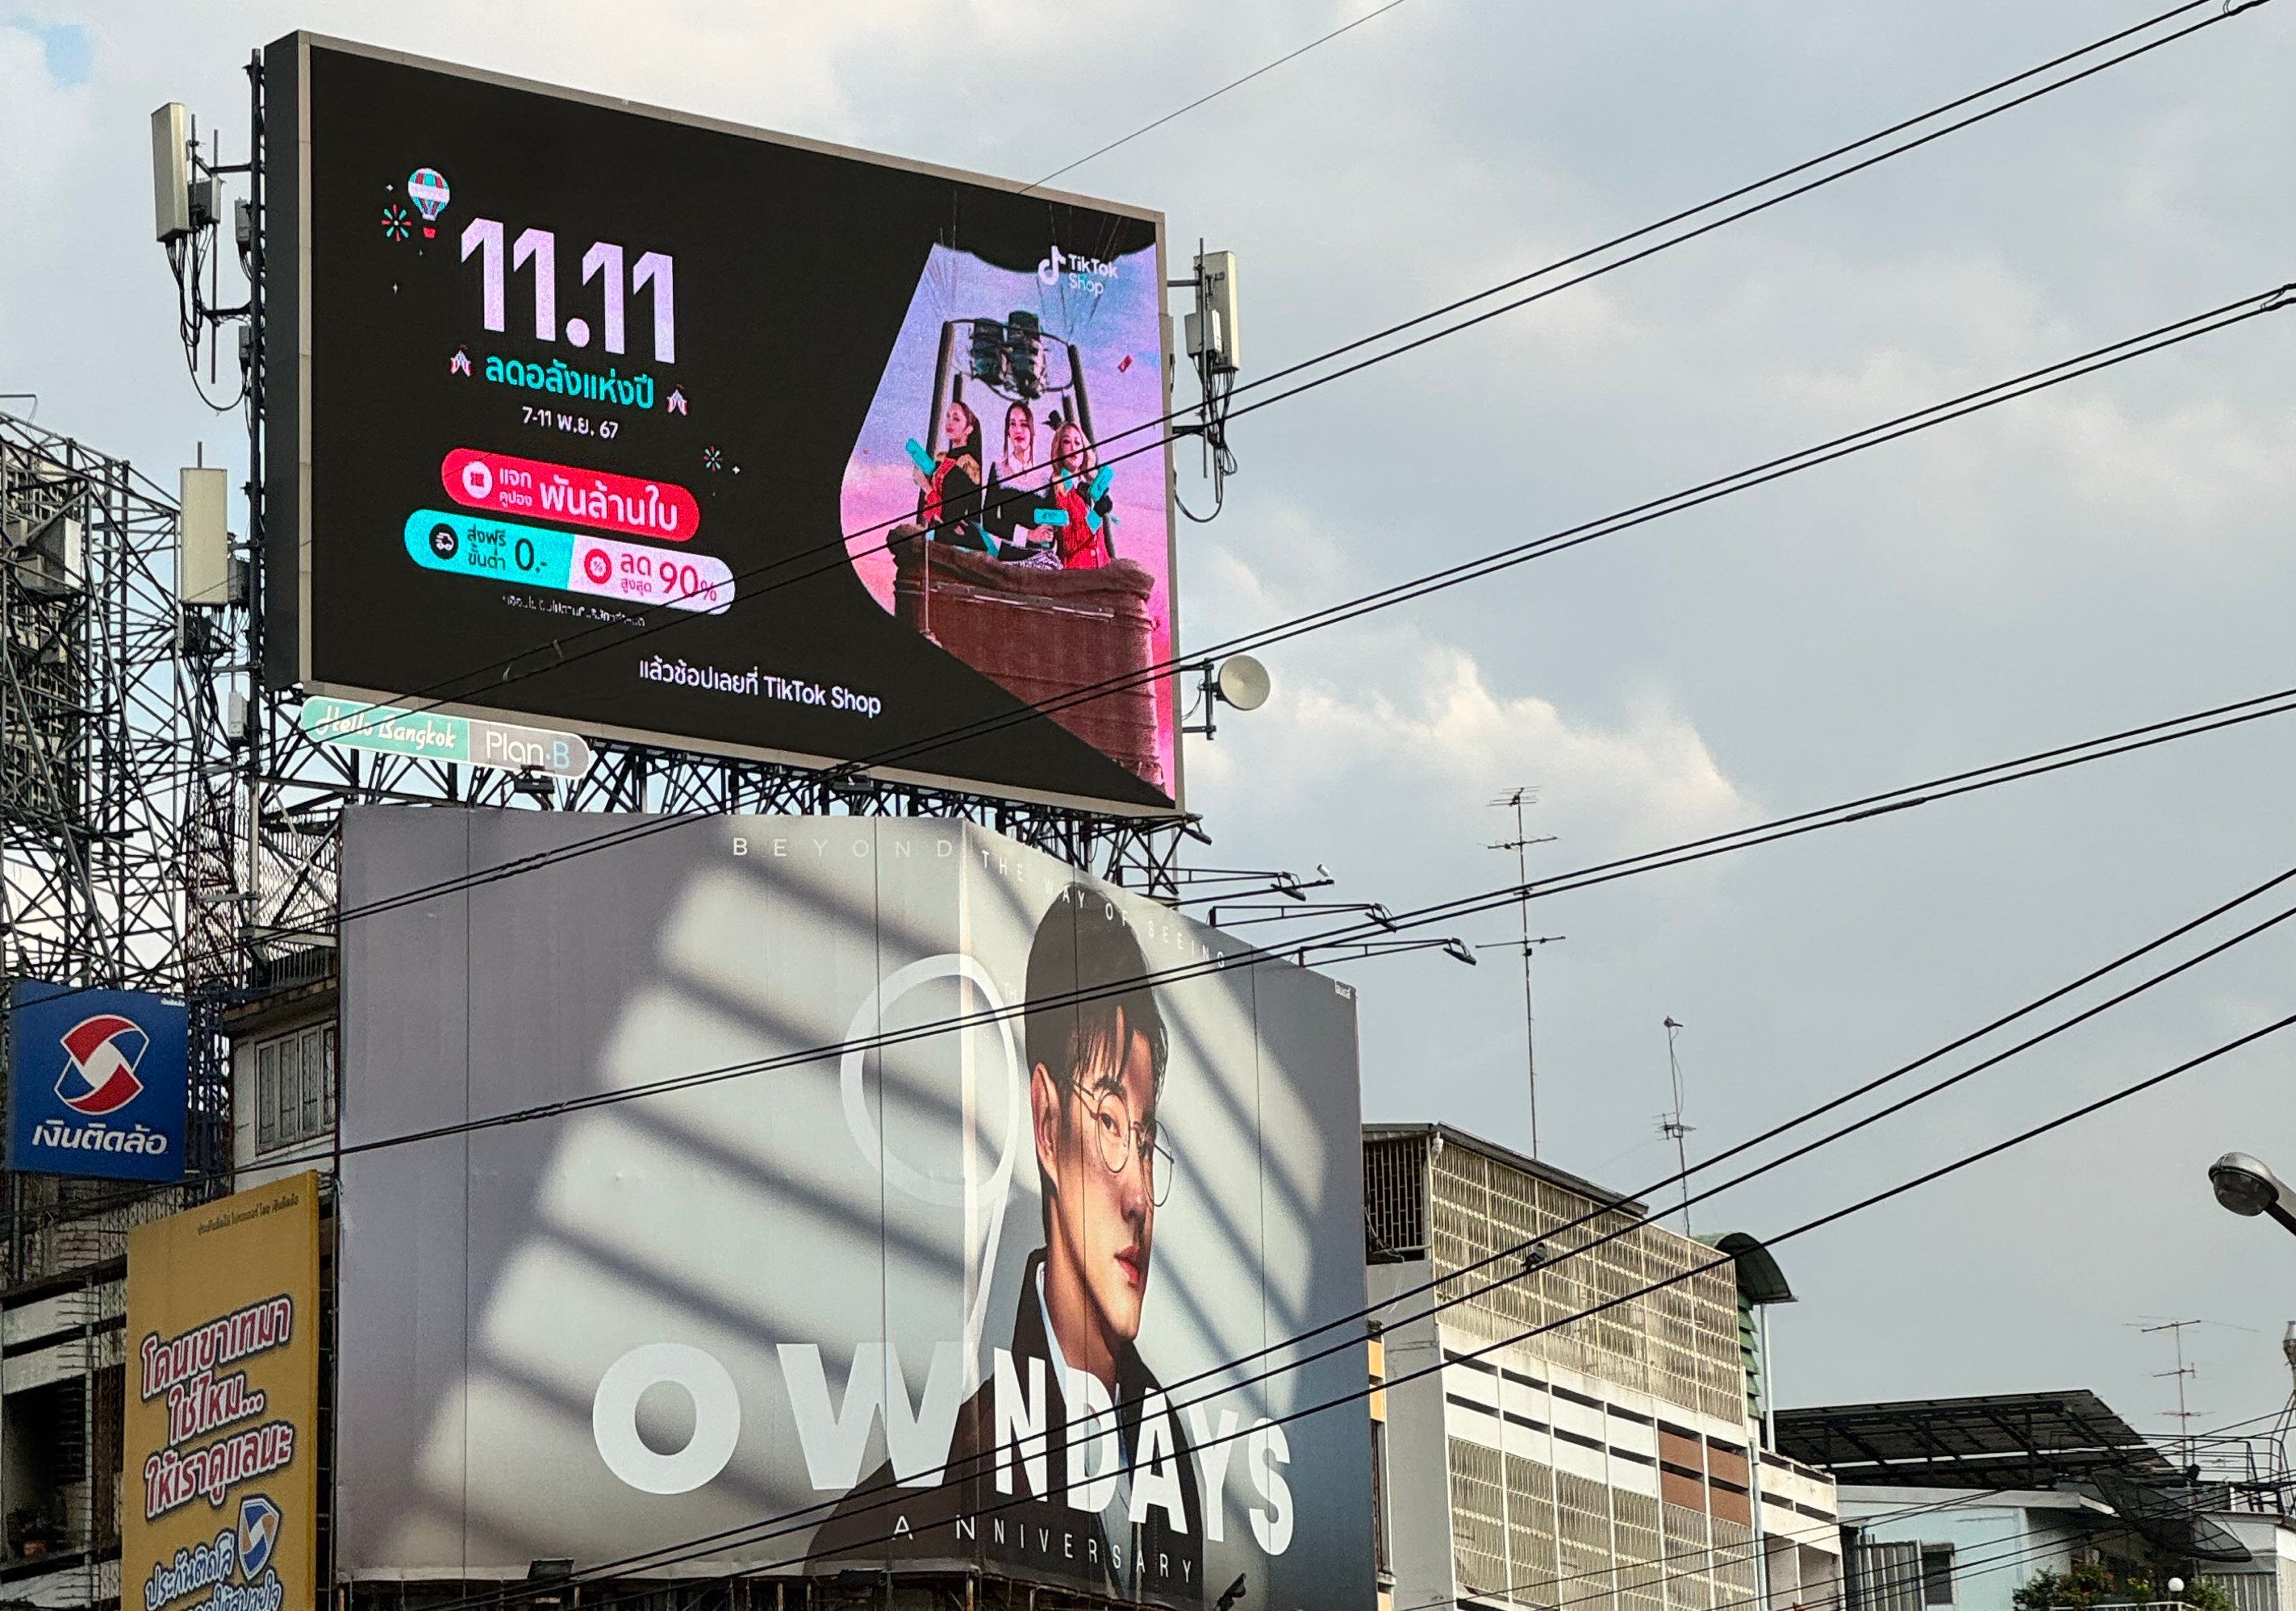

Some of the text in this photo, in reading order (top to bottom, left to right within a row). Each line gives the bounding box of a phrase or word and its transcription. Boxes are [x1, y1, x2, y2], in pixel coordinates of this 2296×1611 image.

[1068, 253, 1118, 278] TikTok
[1069, 272, 1104, 297] Shop
[461, 217, 675, 364] 11.11
[486, 356, 653, 409] ลดอลังแห่งปี
[522, 405, 618, 439] 7-11 พ.ย. 67
[499, 467, 532, 489] แจก
[499, 490, 533, 507] คูปอง
[539, 474, 678, 532] พันล้านใบ
[467, 524, 507, 547] ส่งฟรี
[620, 553, 651, 576] ลด
[659, 561, 717, 602] 90%
[620, 577, 652, 596] สูงสุด
[639, 654, 882, 720] แล้วช้อปเลยที่ TikTok Shop
[314, 704, 457, 752] Hello Bangkok
[732, 837, 954, 859] BEYOND
[981, 849, 1025, 883] THE
[1104, 902, 1129, 927] OF
[31, 1119, 169, 1156] เงินติดล้อ
[592, 1342, 1293, 1556] OWNDAYS
[144, 1424, 294, 1518] ให้เราดูแลนะ
[892, 1513, 1193, 1584] ANNIVERSARY
